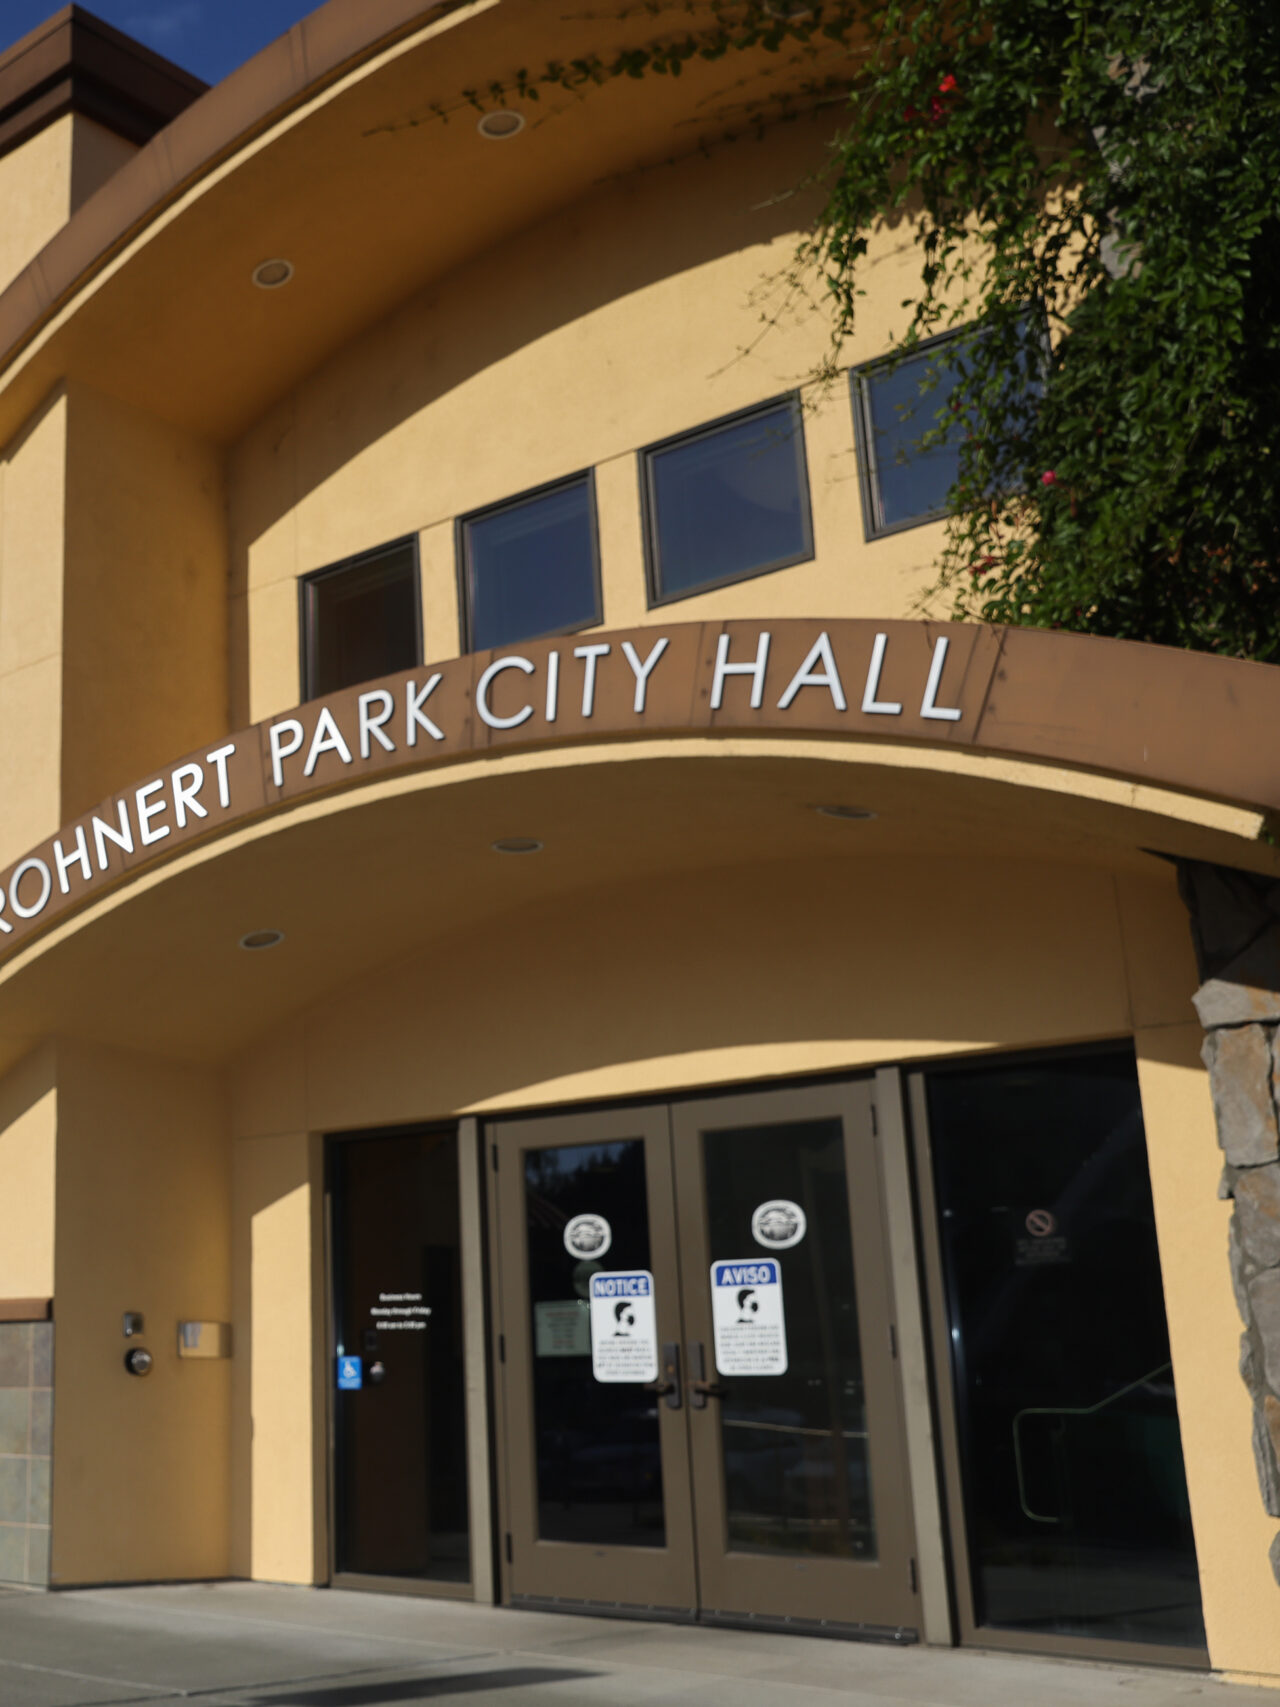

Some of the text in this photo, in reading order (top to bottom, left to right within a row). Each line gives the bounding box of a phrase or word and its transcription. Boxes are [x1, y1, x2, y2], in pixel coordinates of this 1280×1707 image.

[269, 672, 444, 786] PARK
[474, 636, 669, 729] CITY
[709, 630, 962, 722] HALL
[721, 1264, 771, 1285] AVISO
[593, 1277, 649, 1297] NOTICE
